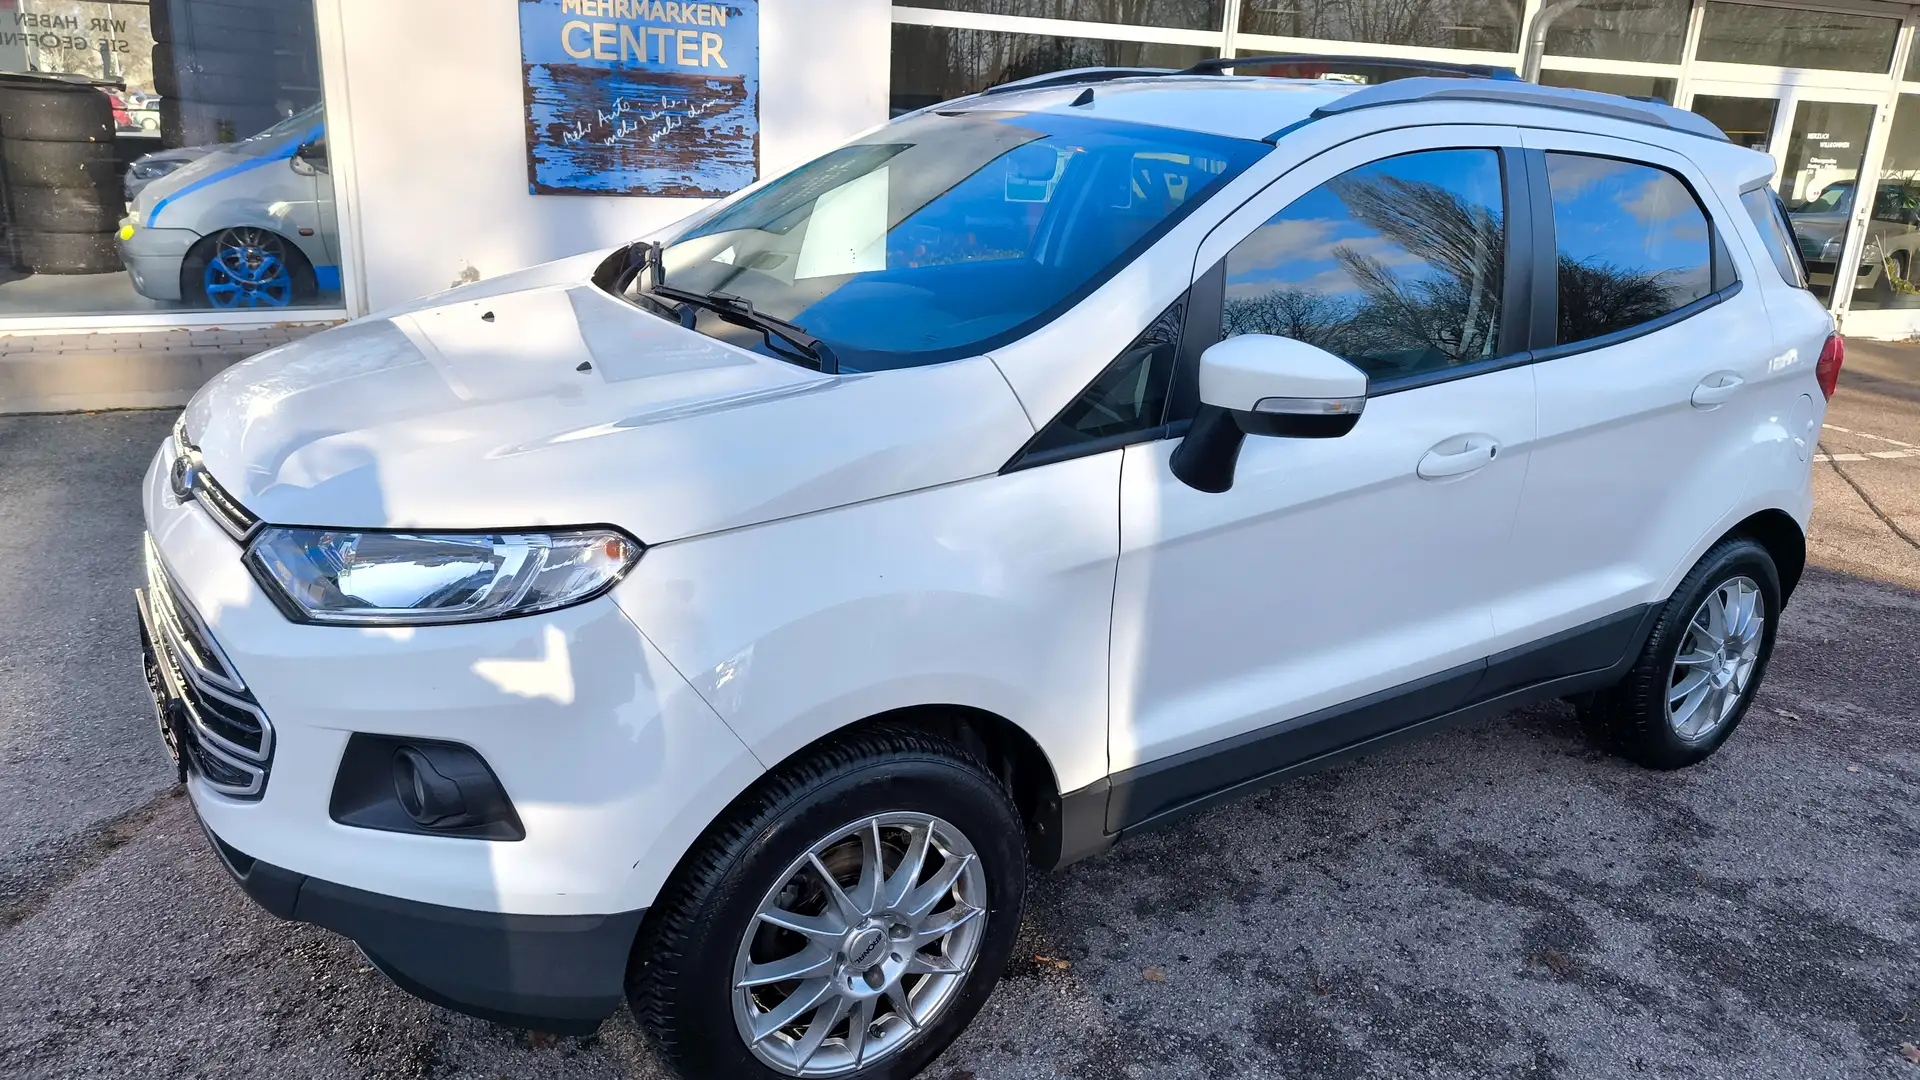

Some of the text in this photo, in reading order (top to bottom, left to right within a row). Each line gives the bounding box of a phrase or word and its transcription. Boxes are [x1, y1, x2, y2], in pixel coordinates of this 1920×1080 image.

[561, 0, 726, 27] MEHRMARKEN
[561, 20, 728, 69] CENTER
[854, 937, 880, 964] RONAL
